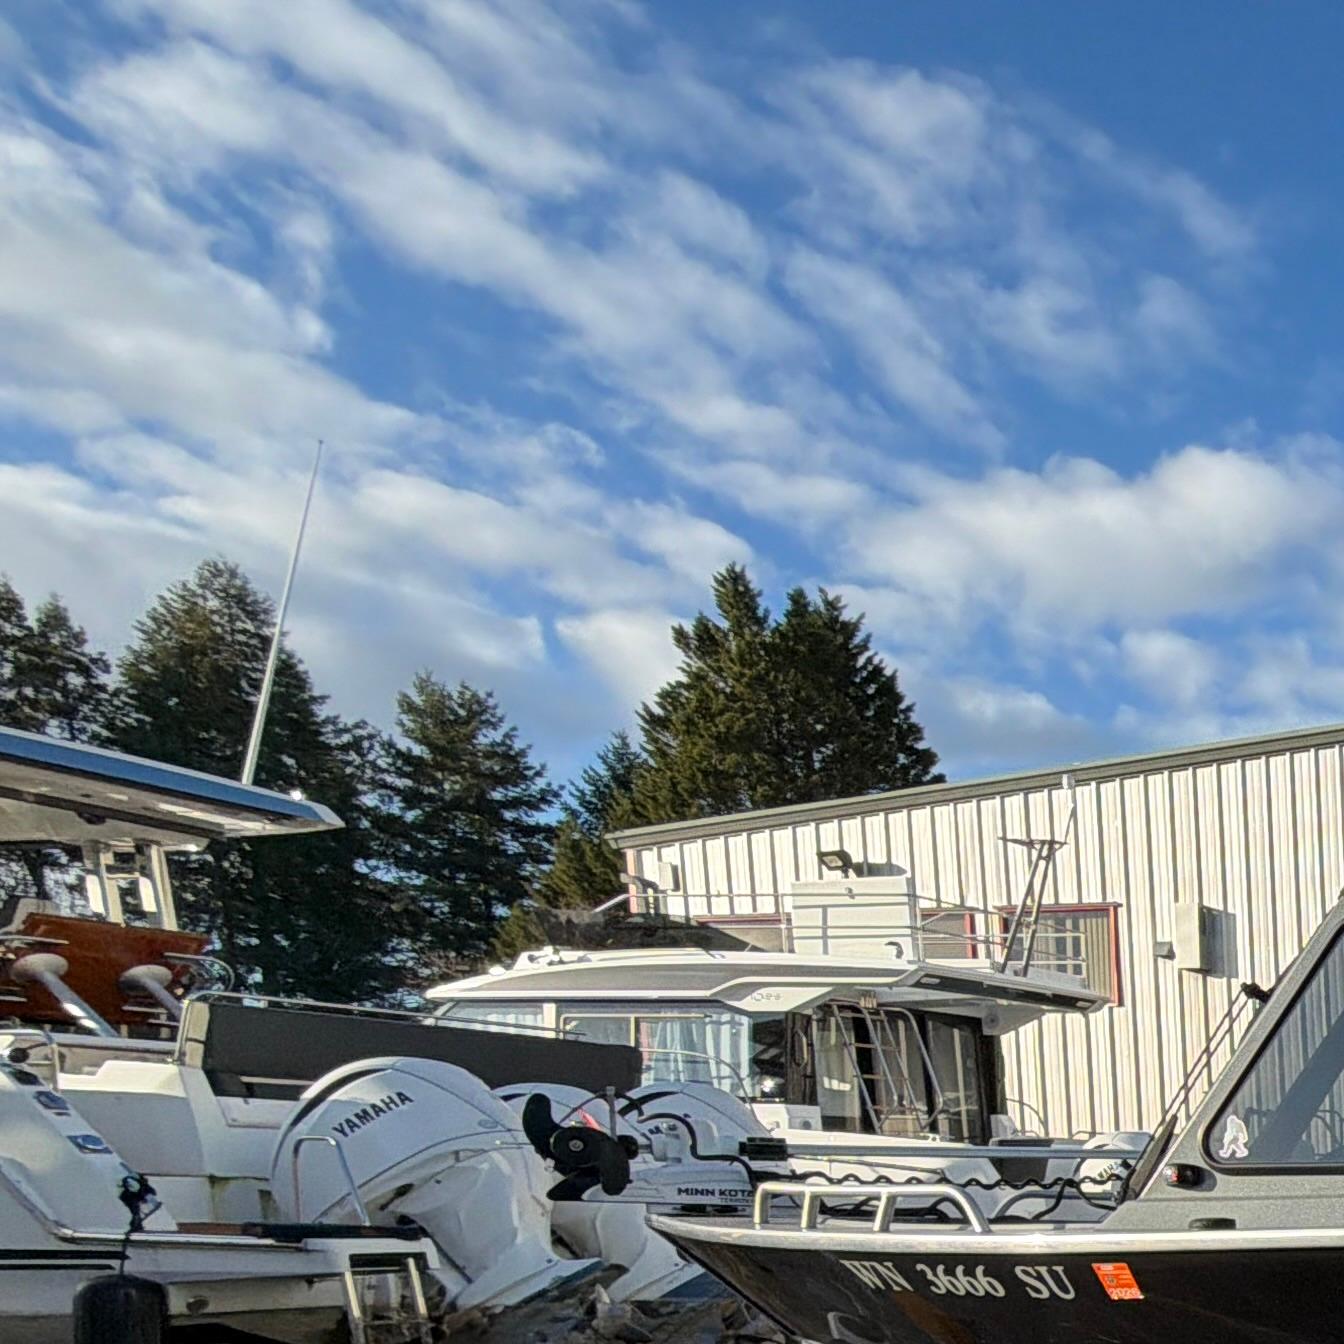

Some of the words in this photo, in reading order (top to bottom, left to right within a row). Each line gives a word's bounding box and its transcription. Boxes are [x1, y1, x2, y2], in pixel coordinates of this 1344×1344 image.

[332, 1091, 415, 1138] YAMAHA
[677, 1187, 716, 1197] MINN
[839, 1259, 914, 1292] WN
[915, 1263, 1005, 1298] 3666
[1015, 1265, 1076, 1300] SU
